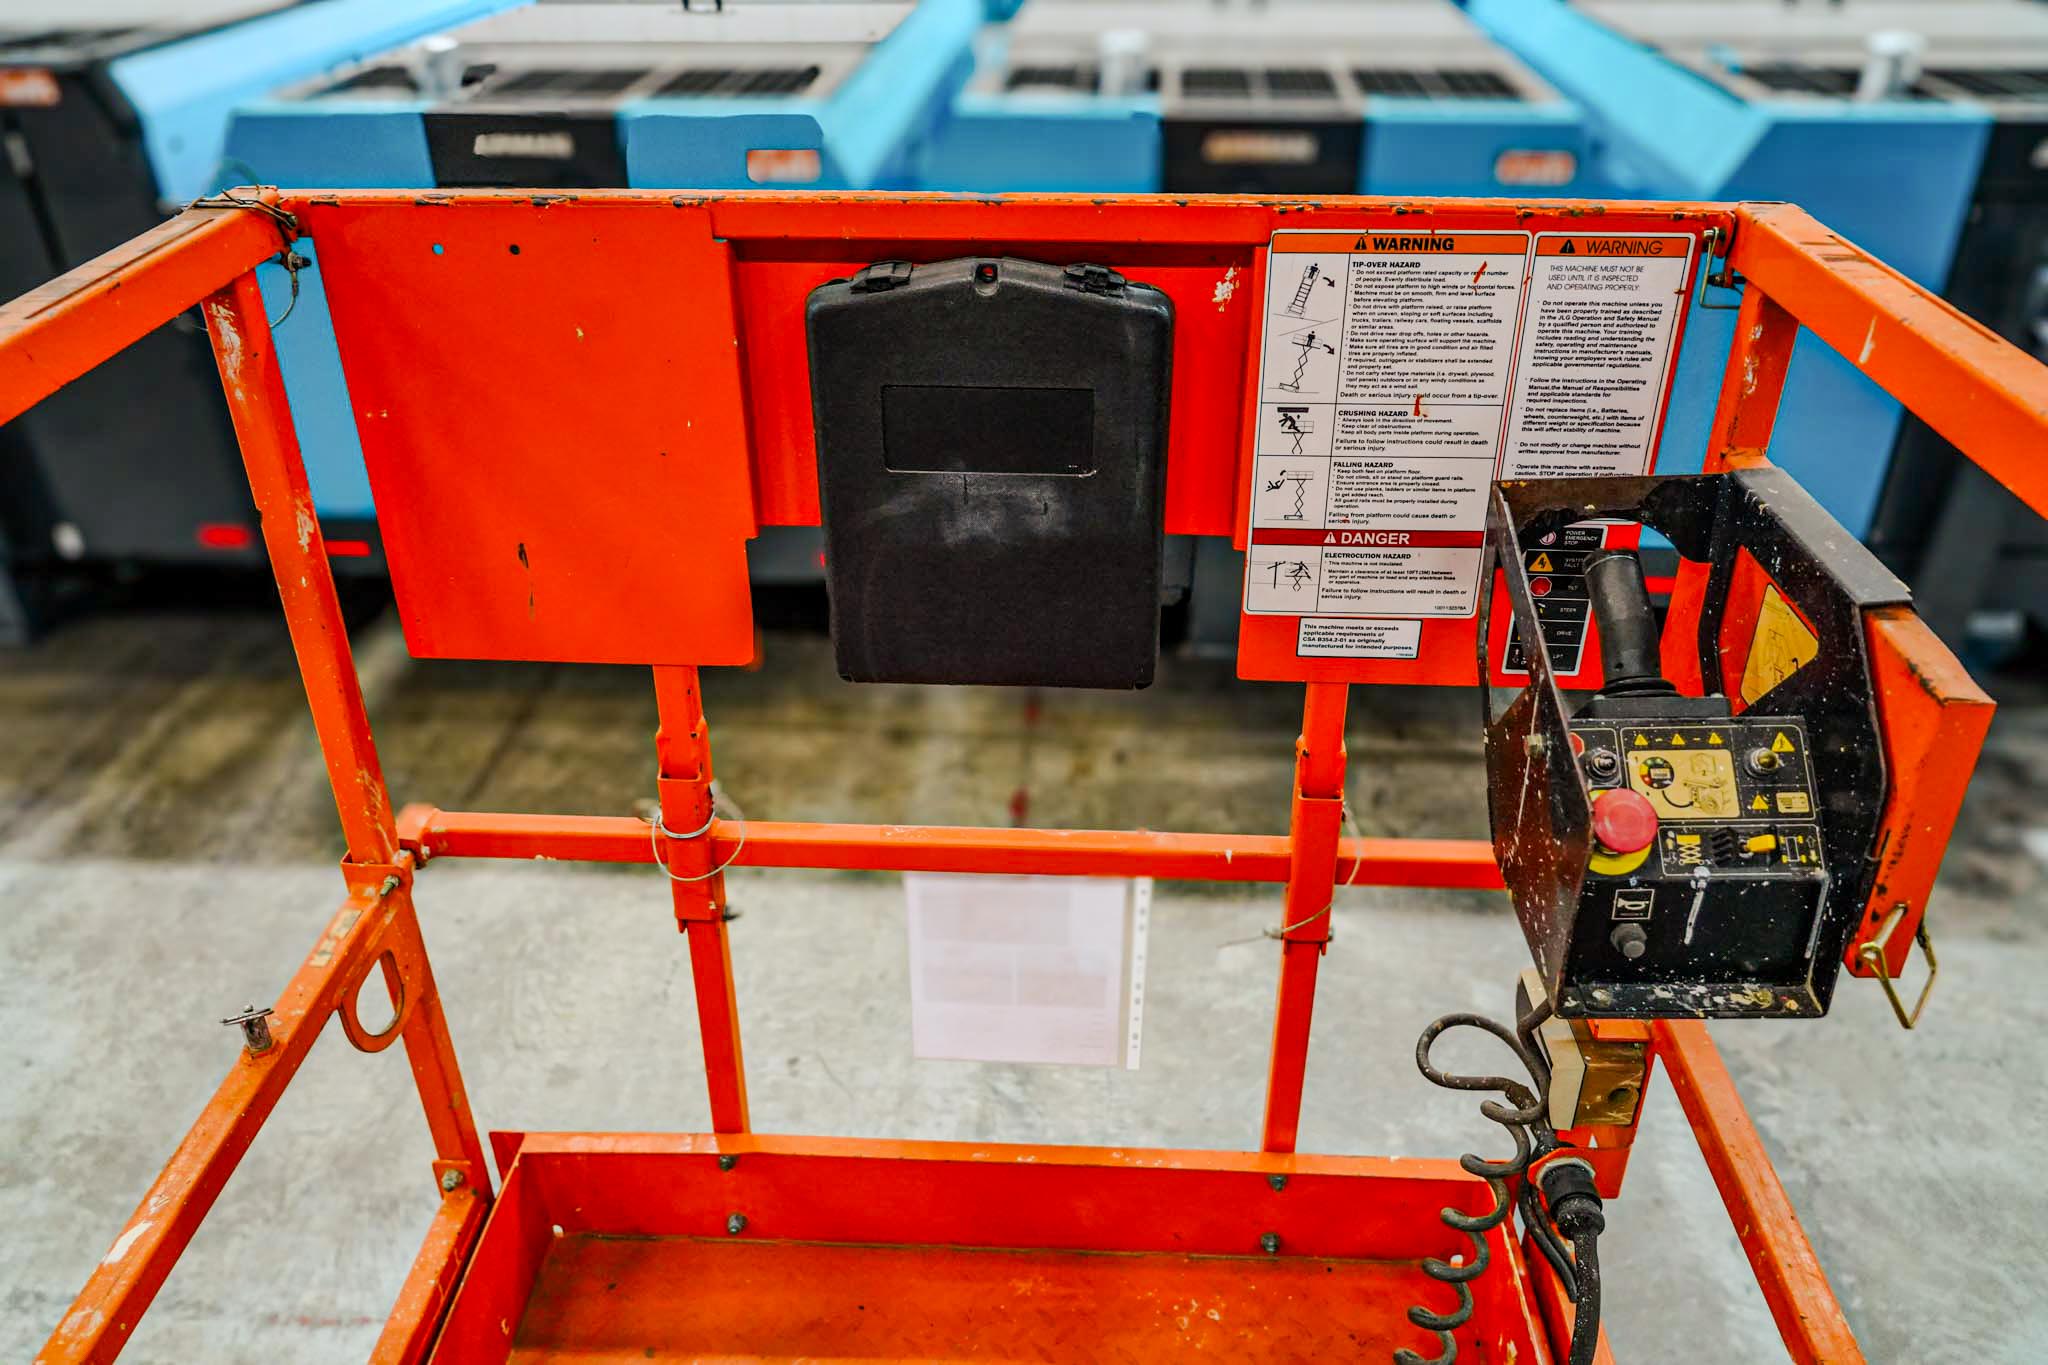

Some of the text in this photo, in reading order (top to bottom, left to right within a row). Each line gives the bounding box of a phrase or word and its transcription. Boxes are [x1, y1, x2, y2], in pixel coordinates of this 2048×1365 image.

[1372, 237, 1455, 251] WARNING
[1585, 239, 1663, 254] WARNING
[1341, 532, 1409, 544] DANGER
